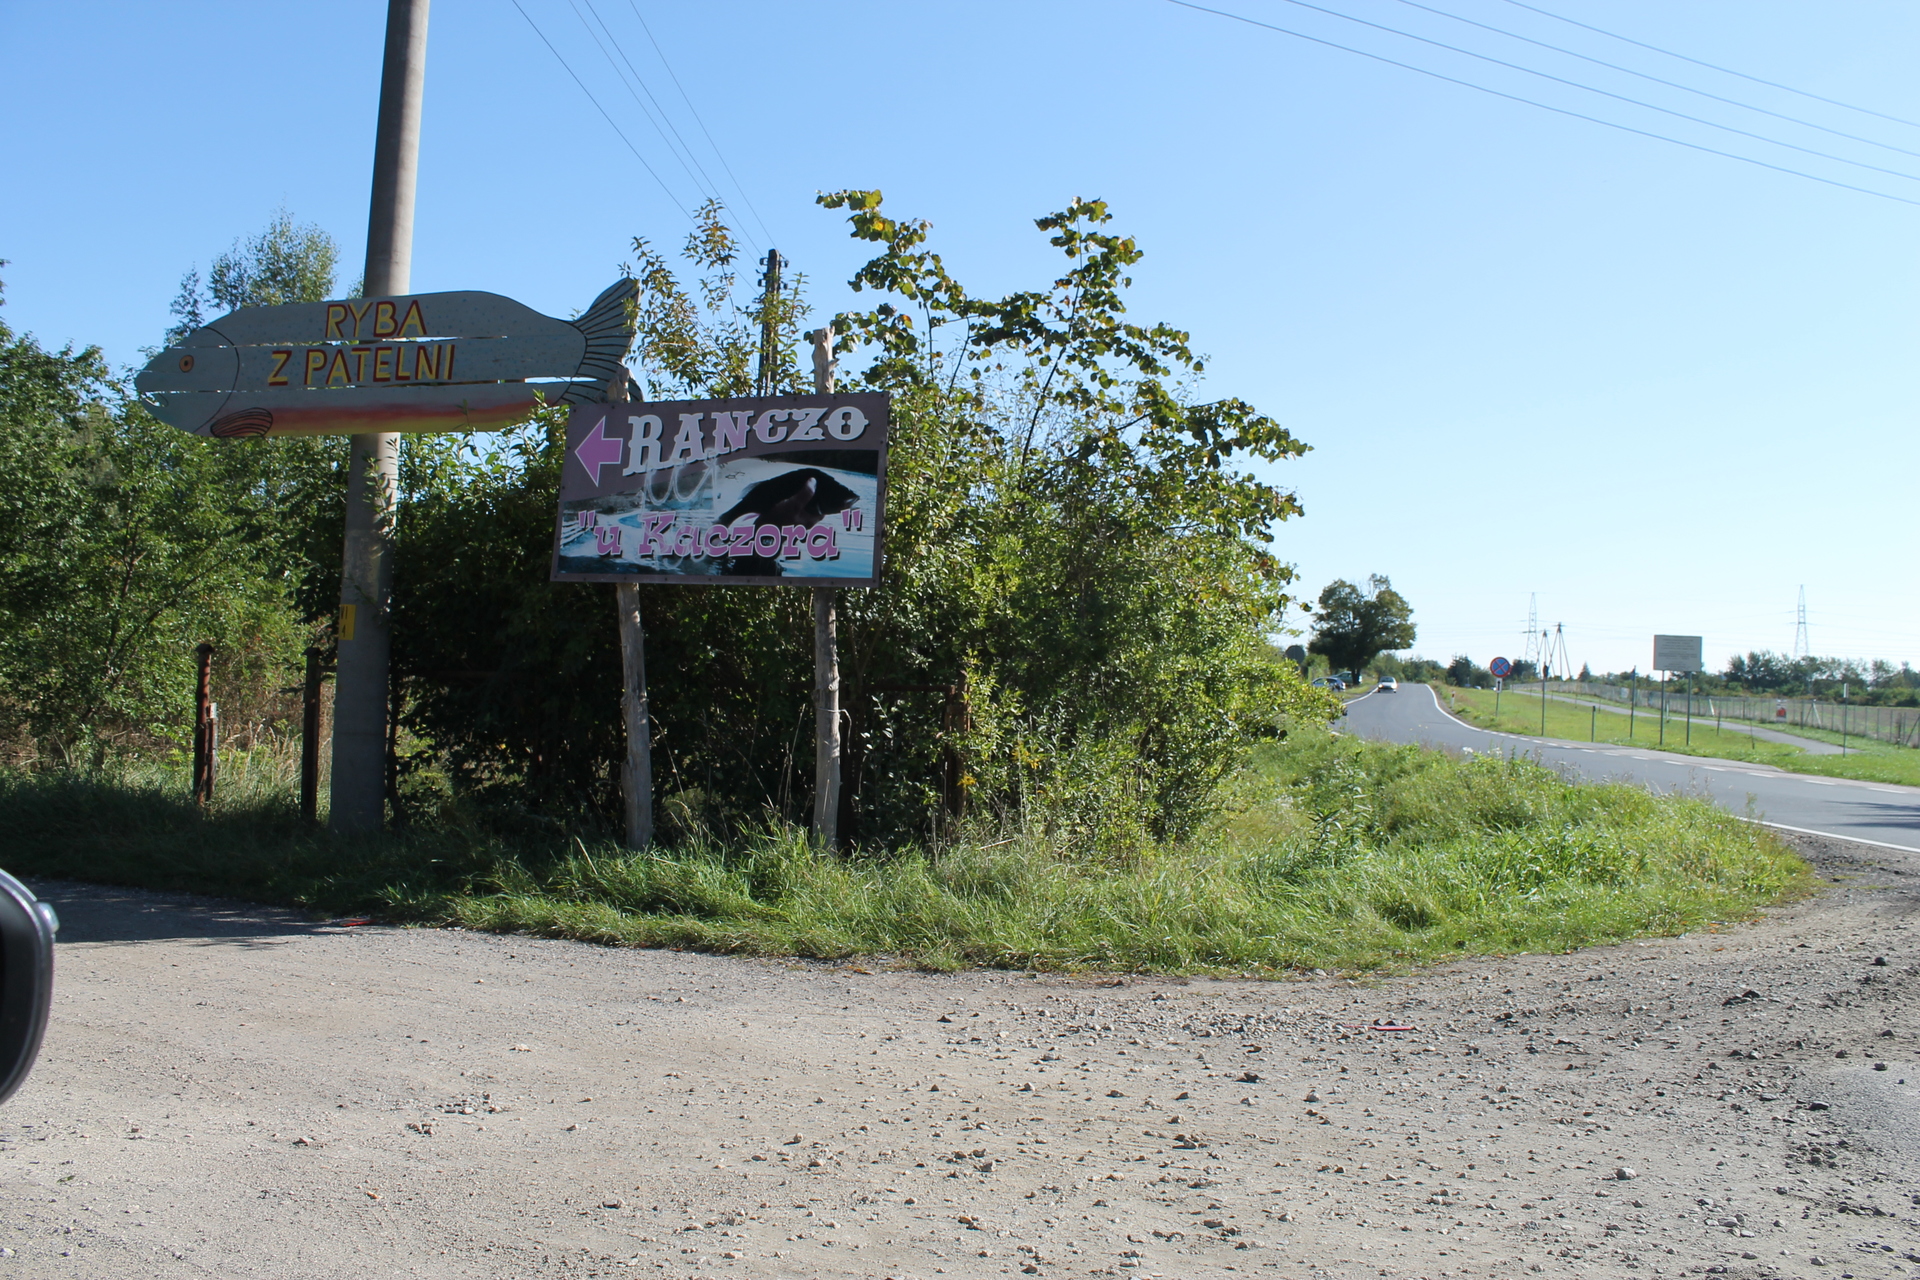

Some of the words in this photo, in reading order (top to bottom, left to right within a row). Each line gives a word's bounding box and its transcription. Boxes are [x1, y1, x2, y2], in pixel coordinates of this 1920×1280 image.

[325, 300, 427, 338] RYBA
[267, 350, 292, 386] Z
[303, 344, 455, 385] PATELNI
[622, 406, 869, 477] RANCZO
[578, 510, 622, 556] "u
[638, 509, 862, 559] Kaczora"
